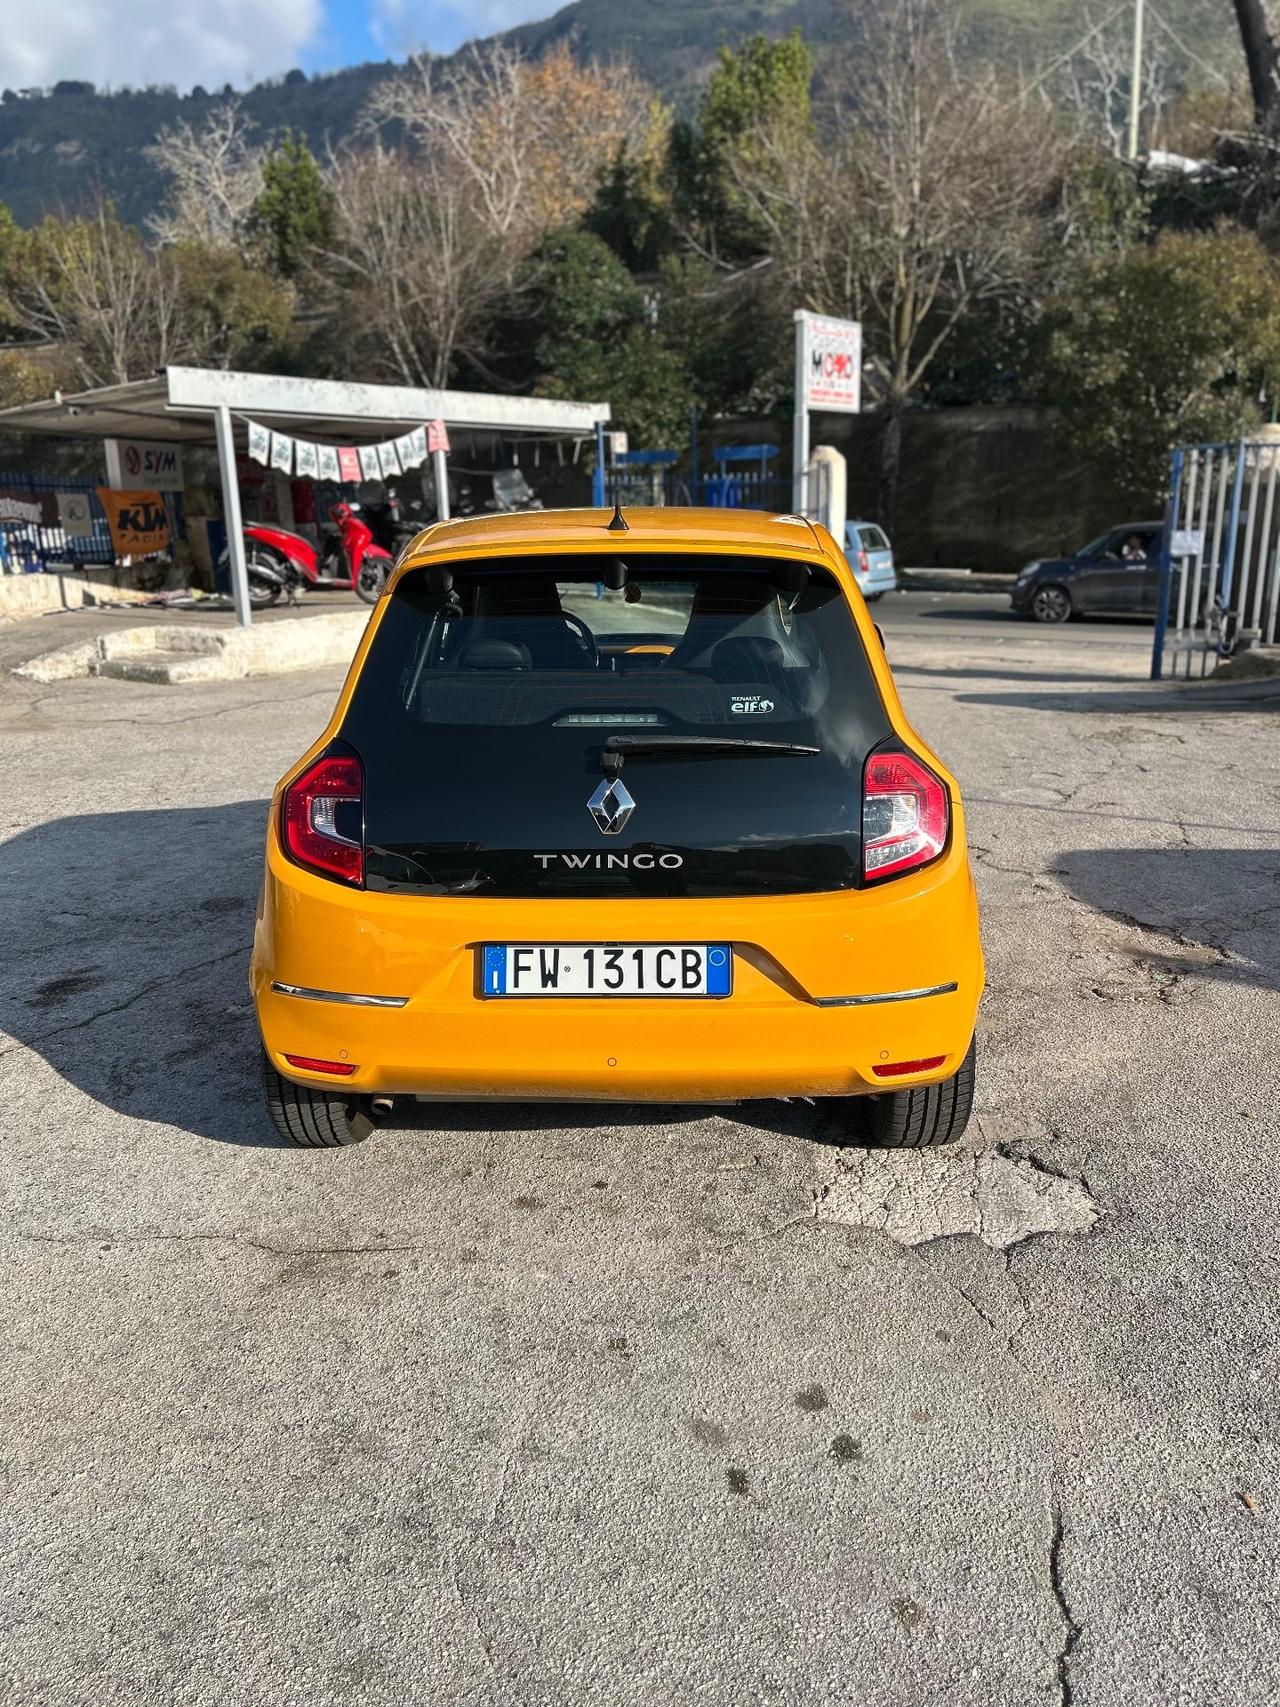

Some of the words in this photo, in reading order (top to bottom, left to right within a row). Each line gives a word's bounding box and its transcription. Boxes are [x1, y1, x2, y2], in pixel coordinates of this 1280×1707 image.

[144, 451, 177, 473] SYM
[731, 701, 759, 712] elf
[533, 853, 684, 869] TWINGO
[513, 948, 560, 988] FW
[583, 948, 702, 989] 131CB
